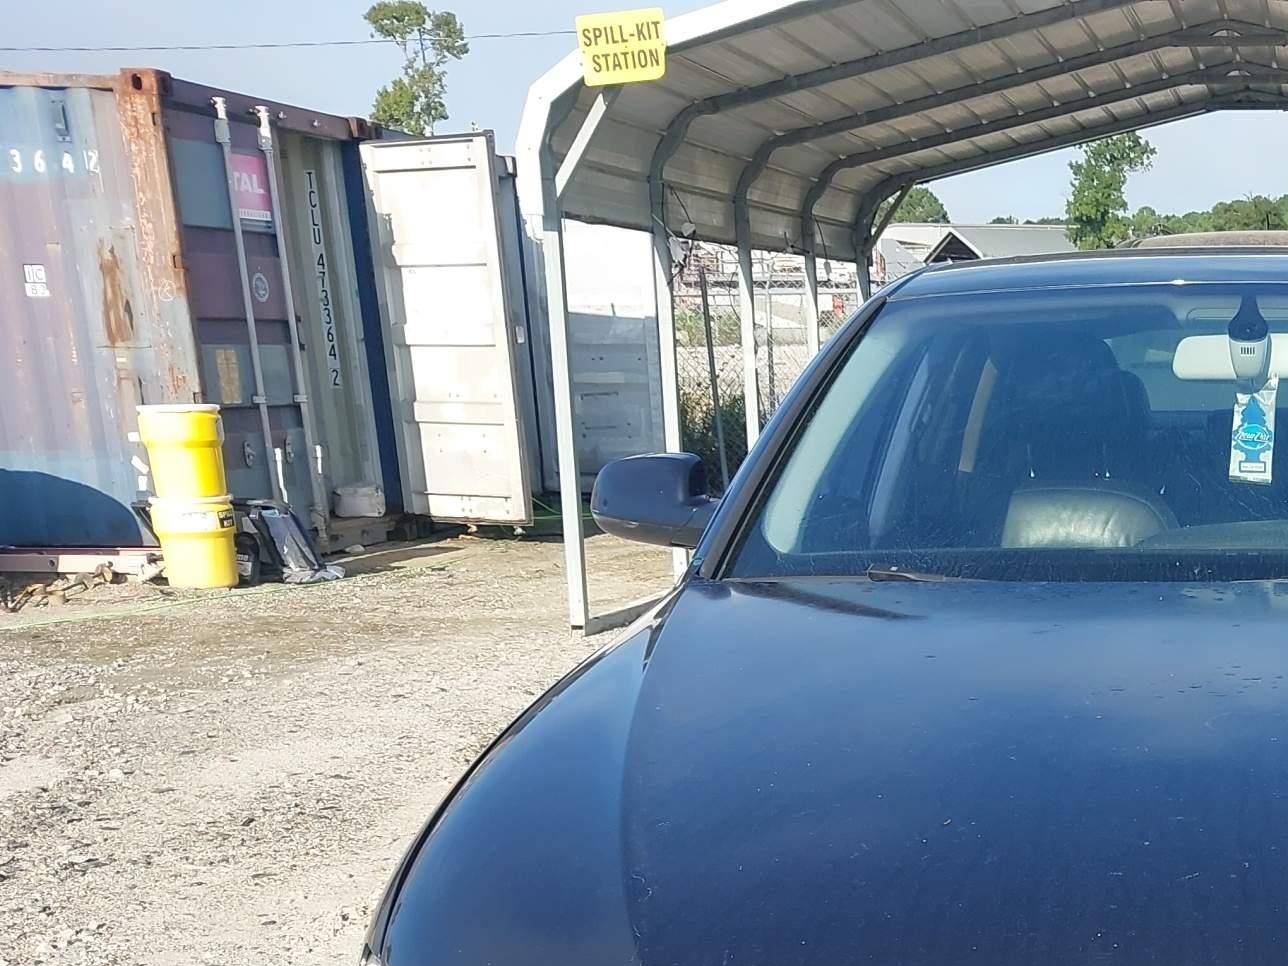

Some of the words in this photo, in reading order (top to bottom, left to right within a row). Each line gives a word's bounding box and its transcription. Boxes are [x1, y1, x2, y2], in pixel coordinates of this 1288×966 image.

[582, 21, 660, 47] SPILL-KIT
[592, 48, 660, 73] STATION
[305, 171, 322, 245] TCLU
[316, 253, 338, 361] 473364
[330, 369, 341, 387] 2
